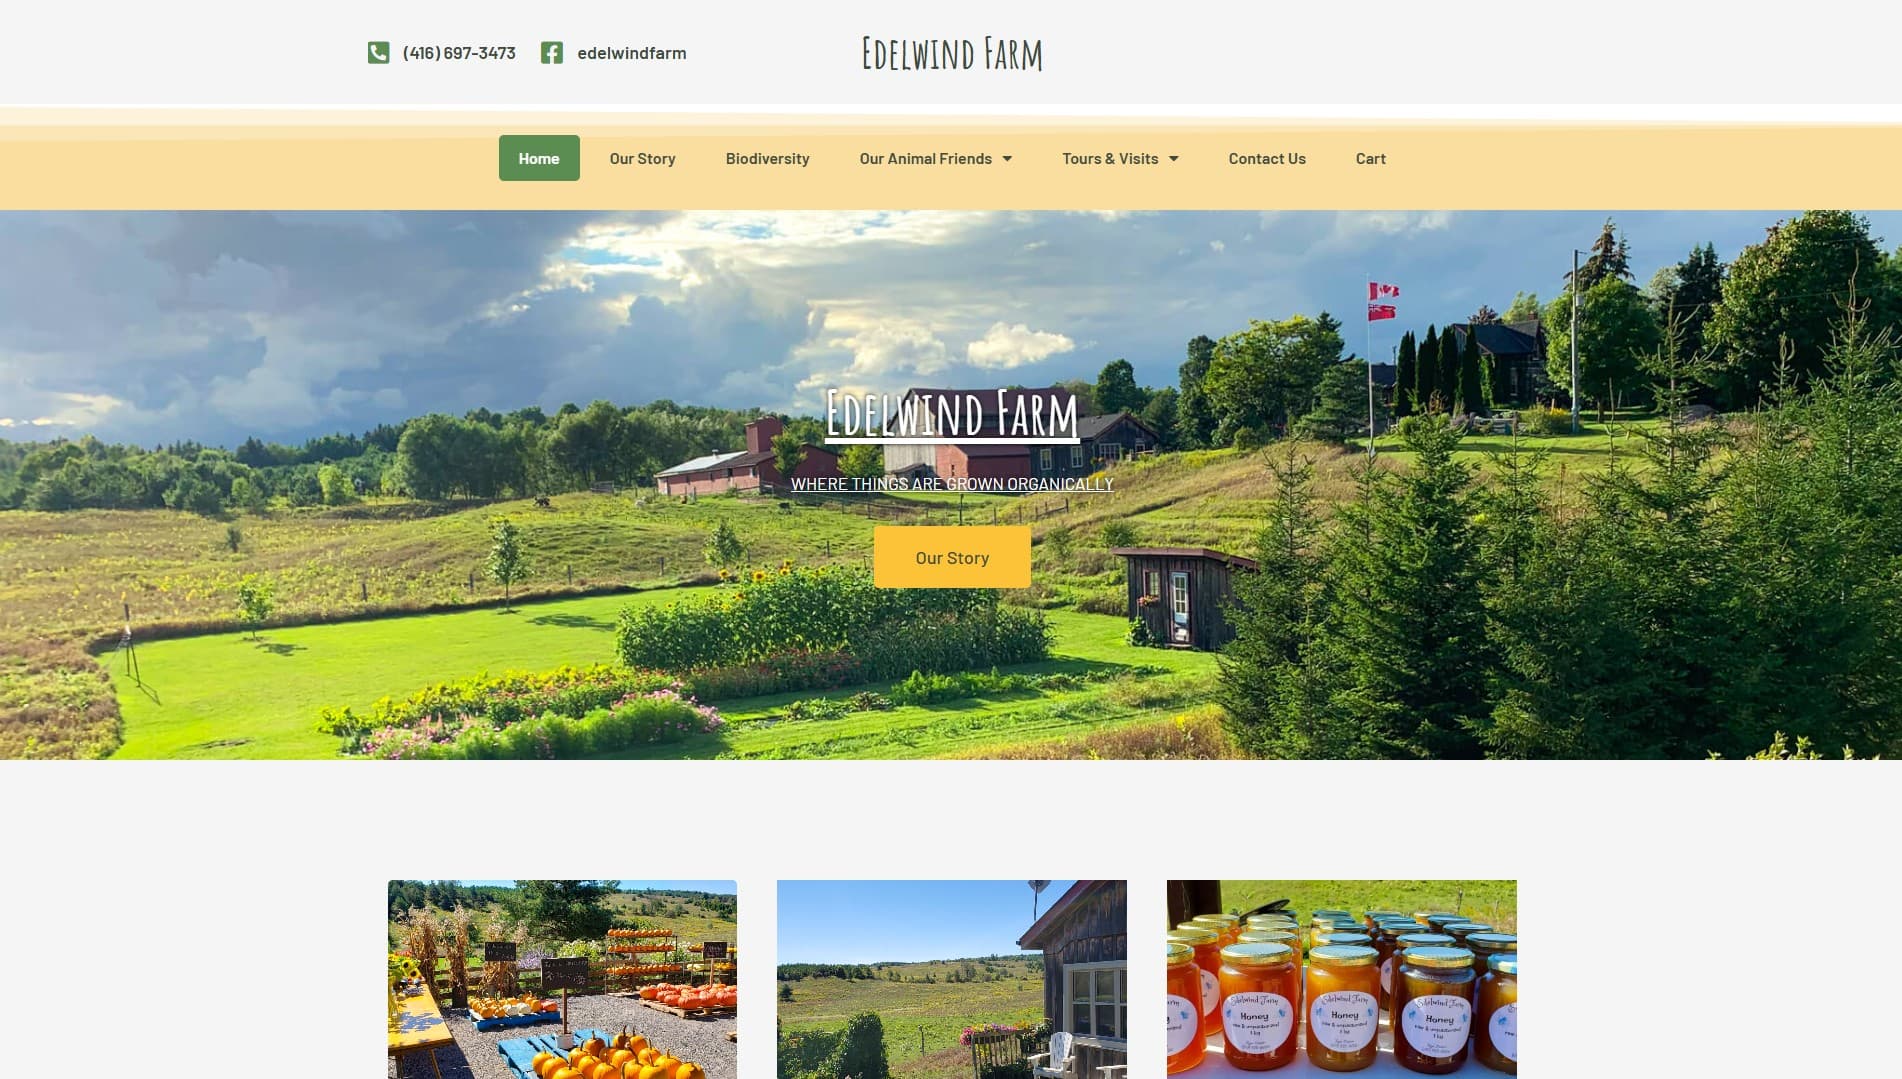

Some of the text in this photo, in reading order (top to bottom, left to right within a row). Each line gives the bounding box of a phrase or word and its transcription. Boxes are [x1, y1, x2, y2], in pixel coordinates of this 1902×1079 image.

[403, 45, 516, 62] (416) 697-3473
[577, 46, 687, 60] edelwindfarm
[519, 152, 560, 165] Home
[610, 152, 676, 168] Our Story
[726, 152, 810, 168] Biodiversity
[860, 152, 993, 165] Our Animal Friends
[1063, 152, 1159, 165] Tours & Visits
[1229, 152, 1307, 165] Contact Us
[1356, 152, 1387, 165] Cart
[916, 551, 990, 568] Our Story
[1240, 1012, 1269, 1022] Honey
[1331, 1011, 1359, 1021] Honey
[1425, 1014, 1454, 1026] Honey
